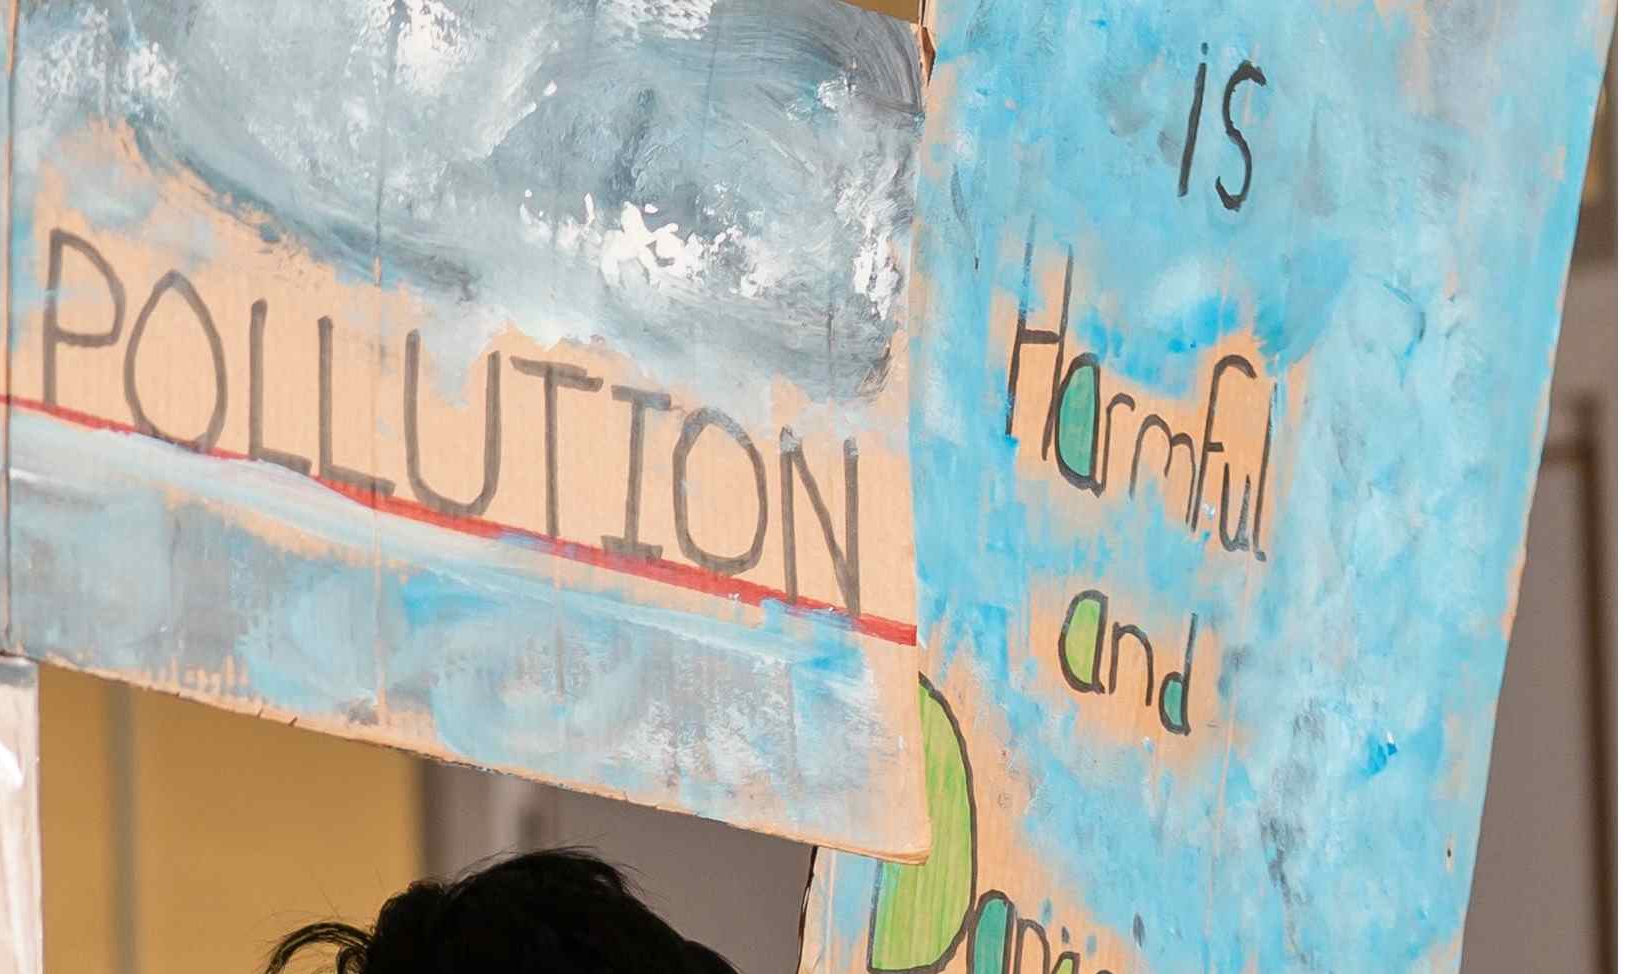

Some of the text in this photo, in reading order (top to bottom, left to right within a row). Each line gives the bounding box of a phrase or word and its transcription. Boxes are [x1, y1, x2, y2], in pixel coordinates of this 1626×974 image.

[1176, 41, 1267, 212] is
[41, 226, 862, 616] POLLUTION
[1004, 212, 1278, 562] Harmful
[1056, 588, 1199, 736] and
